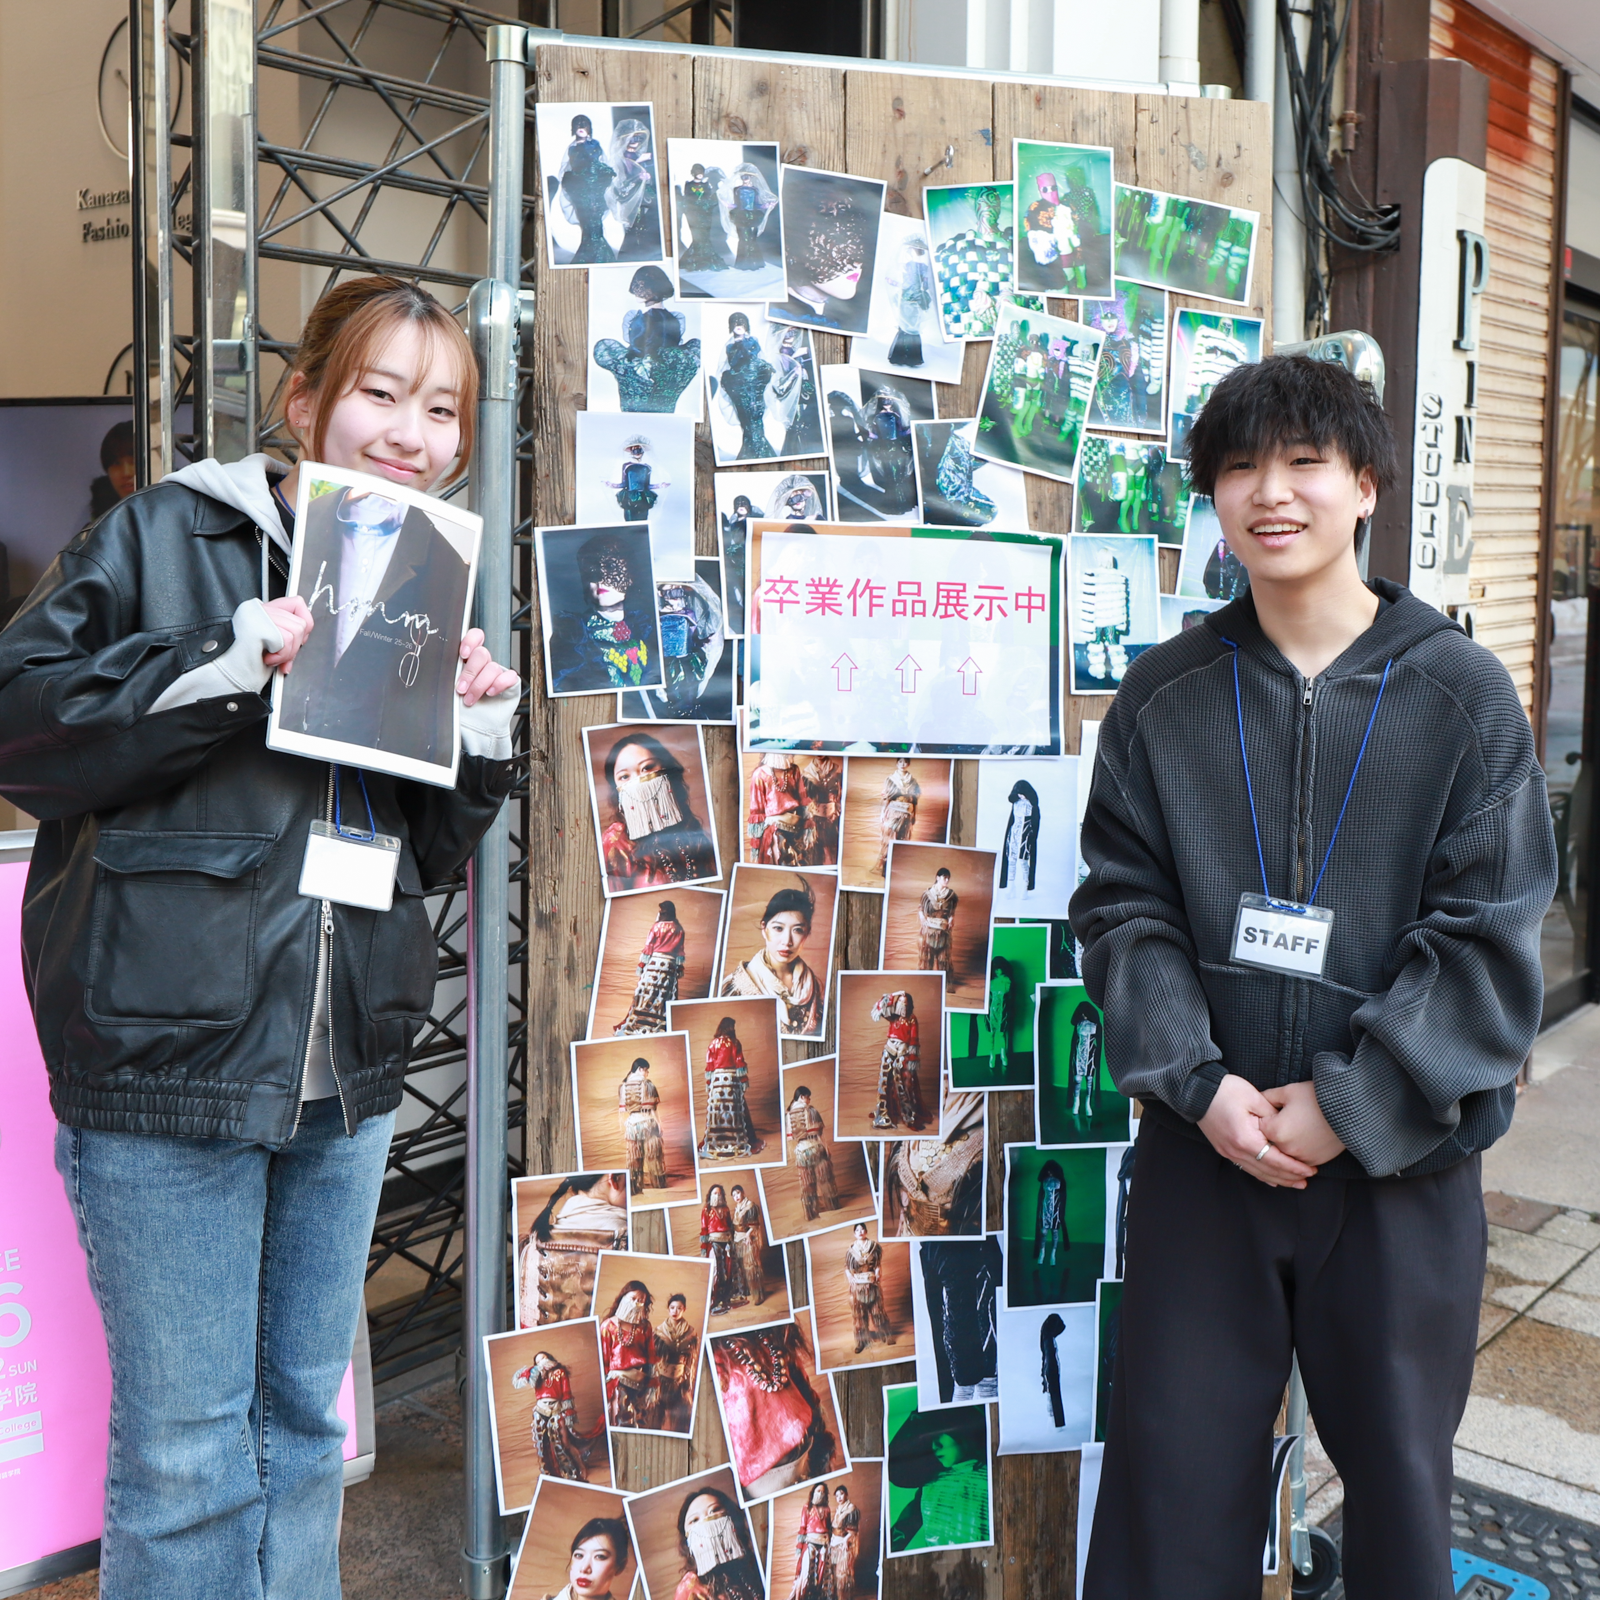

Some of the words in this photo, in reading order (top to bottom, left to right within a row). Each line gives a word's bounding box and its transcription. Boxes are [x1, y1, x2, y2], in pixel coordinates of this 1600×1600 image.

[76, 188, 131, 210] Kanaza
[82, 218, 130, 243] Fashio
[1415, 393, 1443, 569] STUDIO
[763, 575, 1046, 624] 卒業作品展示中
[360, 628, 393, 643] Fall/Winter
[1243, 926, 1320, 954] STAFF
[9, 1360, 37, 1377] SUN
